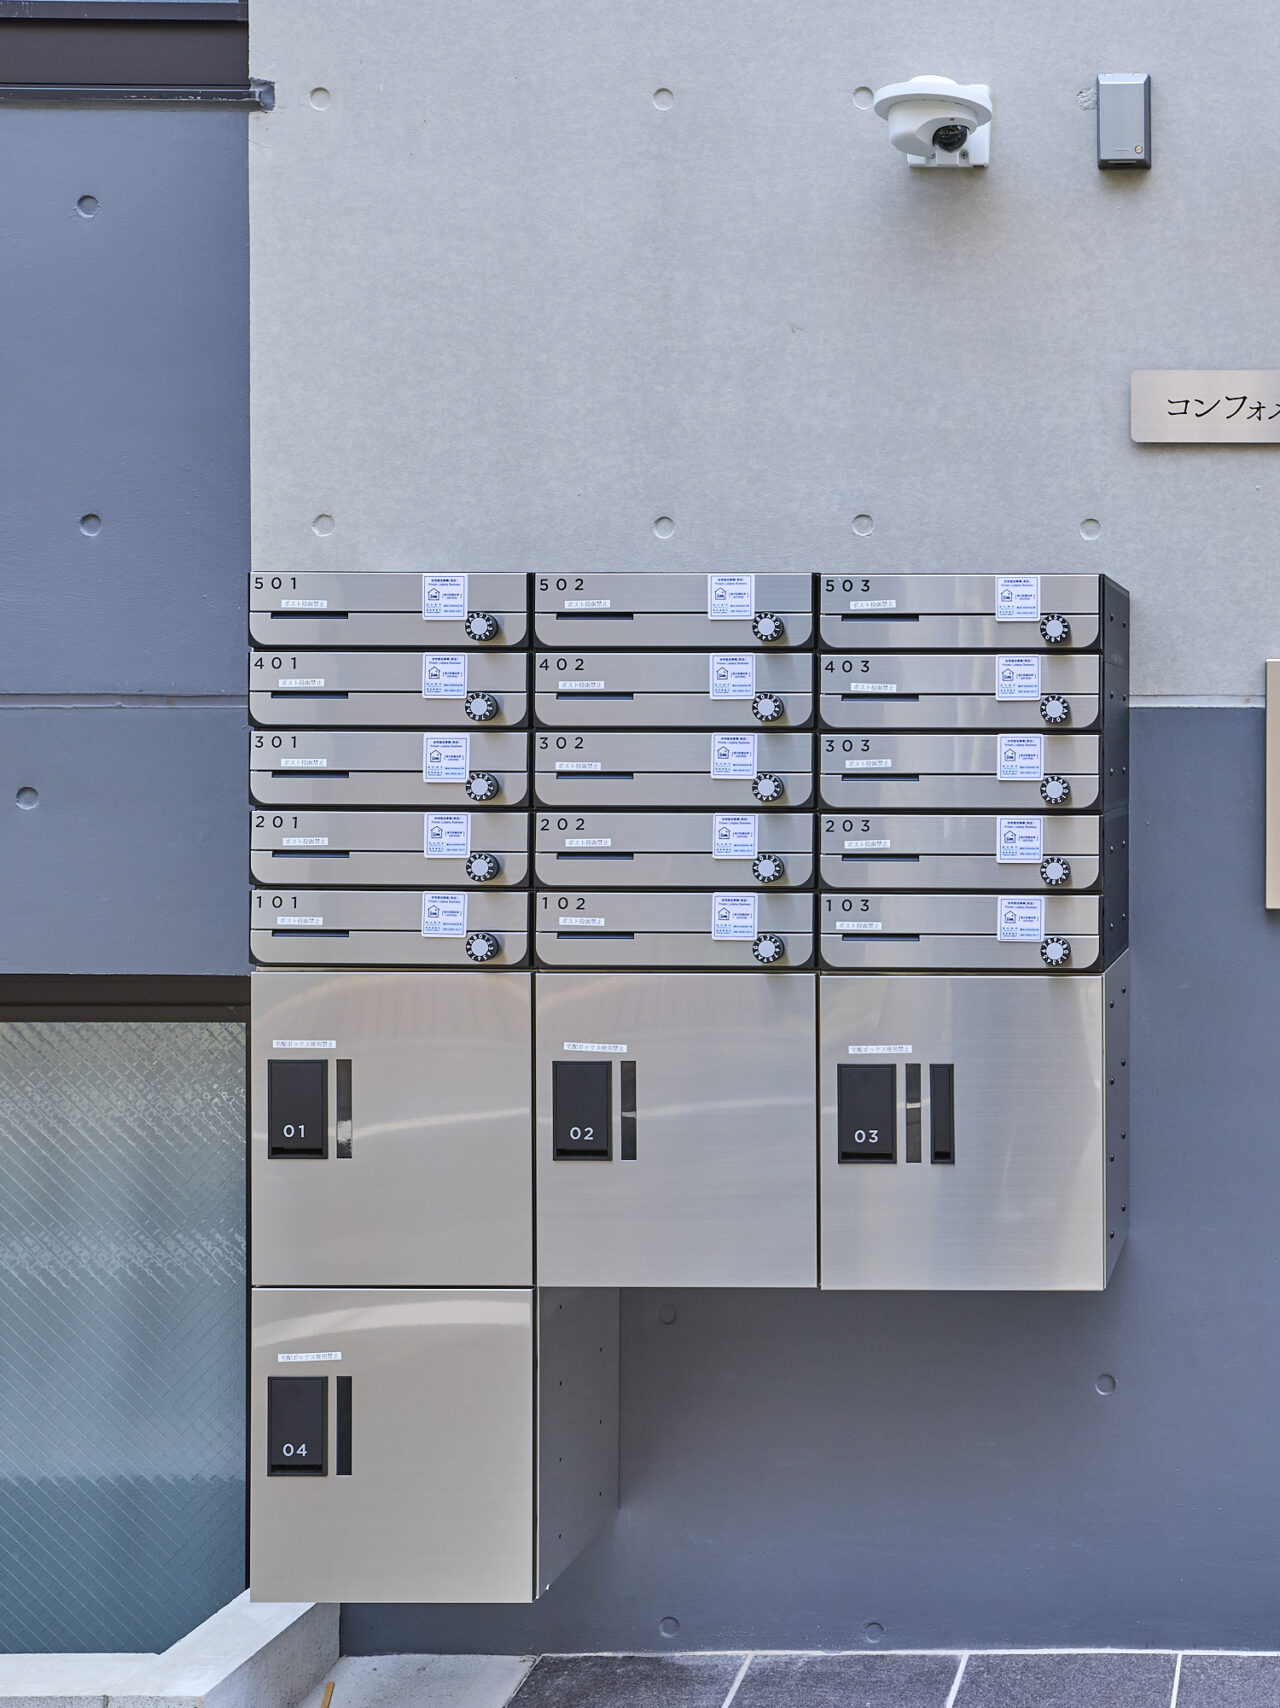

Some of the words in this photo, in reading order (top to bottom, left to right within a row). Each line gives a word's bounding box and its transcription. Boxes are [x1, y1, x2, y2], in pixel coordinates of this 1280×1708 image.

[255, 577, 295, 589] 501
[540, 579, 583, 591] 502
[826, 580, 870, 592] 503
[254, 657, 296, 669] 401
[540, 658, 583, 670] 402
[825, 661, 869, 673] 403
[255, 736, 296, 748] 301
[540, 737, 583, 749] 302
[826, 740, 869, 752] 303
[256, 816, 297, 828] 201
[541, 818, 584, 830] 202
[826, 820, 869, 832] 203
[257, 896, 296, 908] 101
[543, 897, 585, 910] 102
[826, 899, 869, 911] 103
[284, 1125, 304, 1137] 01
[570, 1127, 593, 1139] 02
[855, 1130, 878, 1142] 03
[283, 1444, 307, 1456] 04
